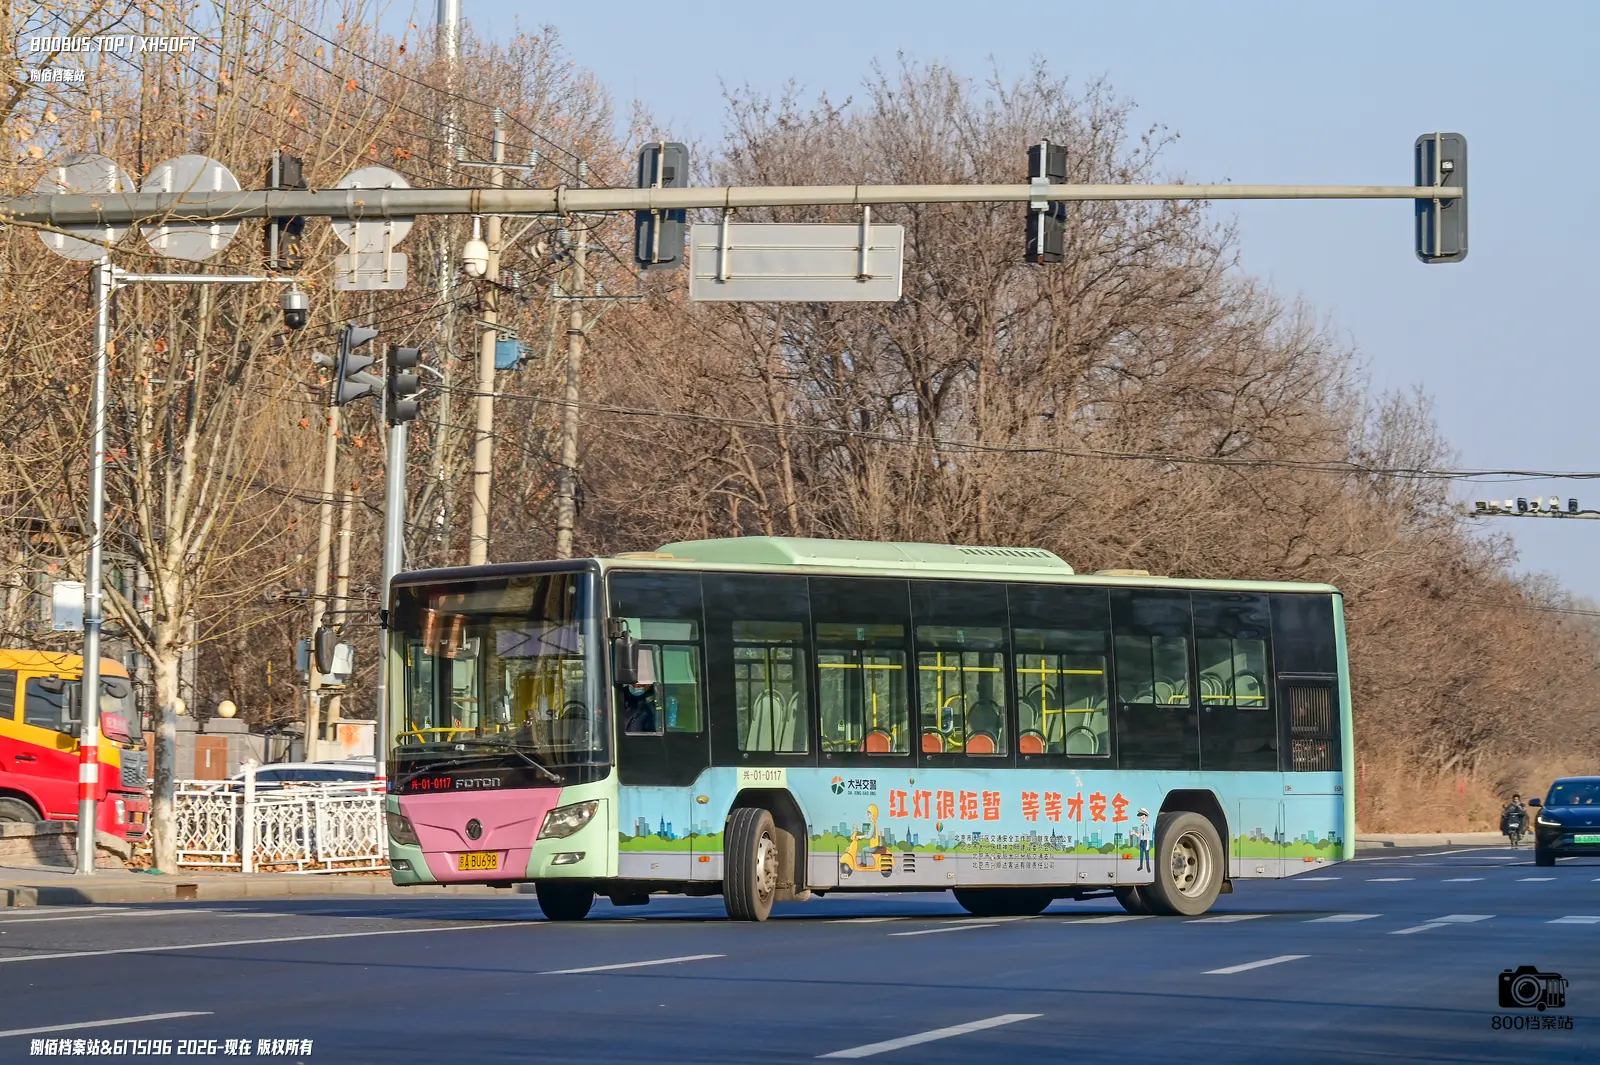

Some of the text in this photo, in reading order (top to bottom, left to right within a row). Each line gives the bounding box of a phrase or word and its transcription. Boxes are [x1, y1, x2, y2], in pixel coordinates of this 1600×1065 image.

[743, 770, 782, 781] 兴-01-0117
[411, 777, 452, 790] 兴-01-0117
[455, 778, 501, 789] FOTON
[847, 779, 877, 790] 大兴交警
[889, 789, 1130, 823] 红灯很短暂 等等才安全
